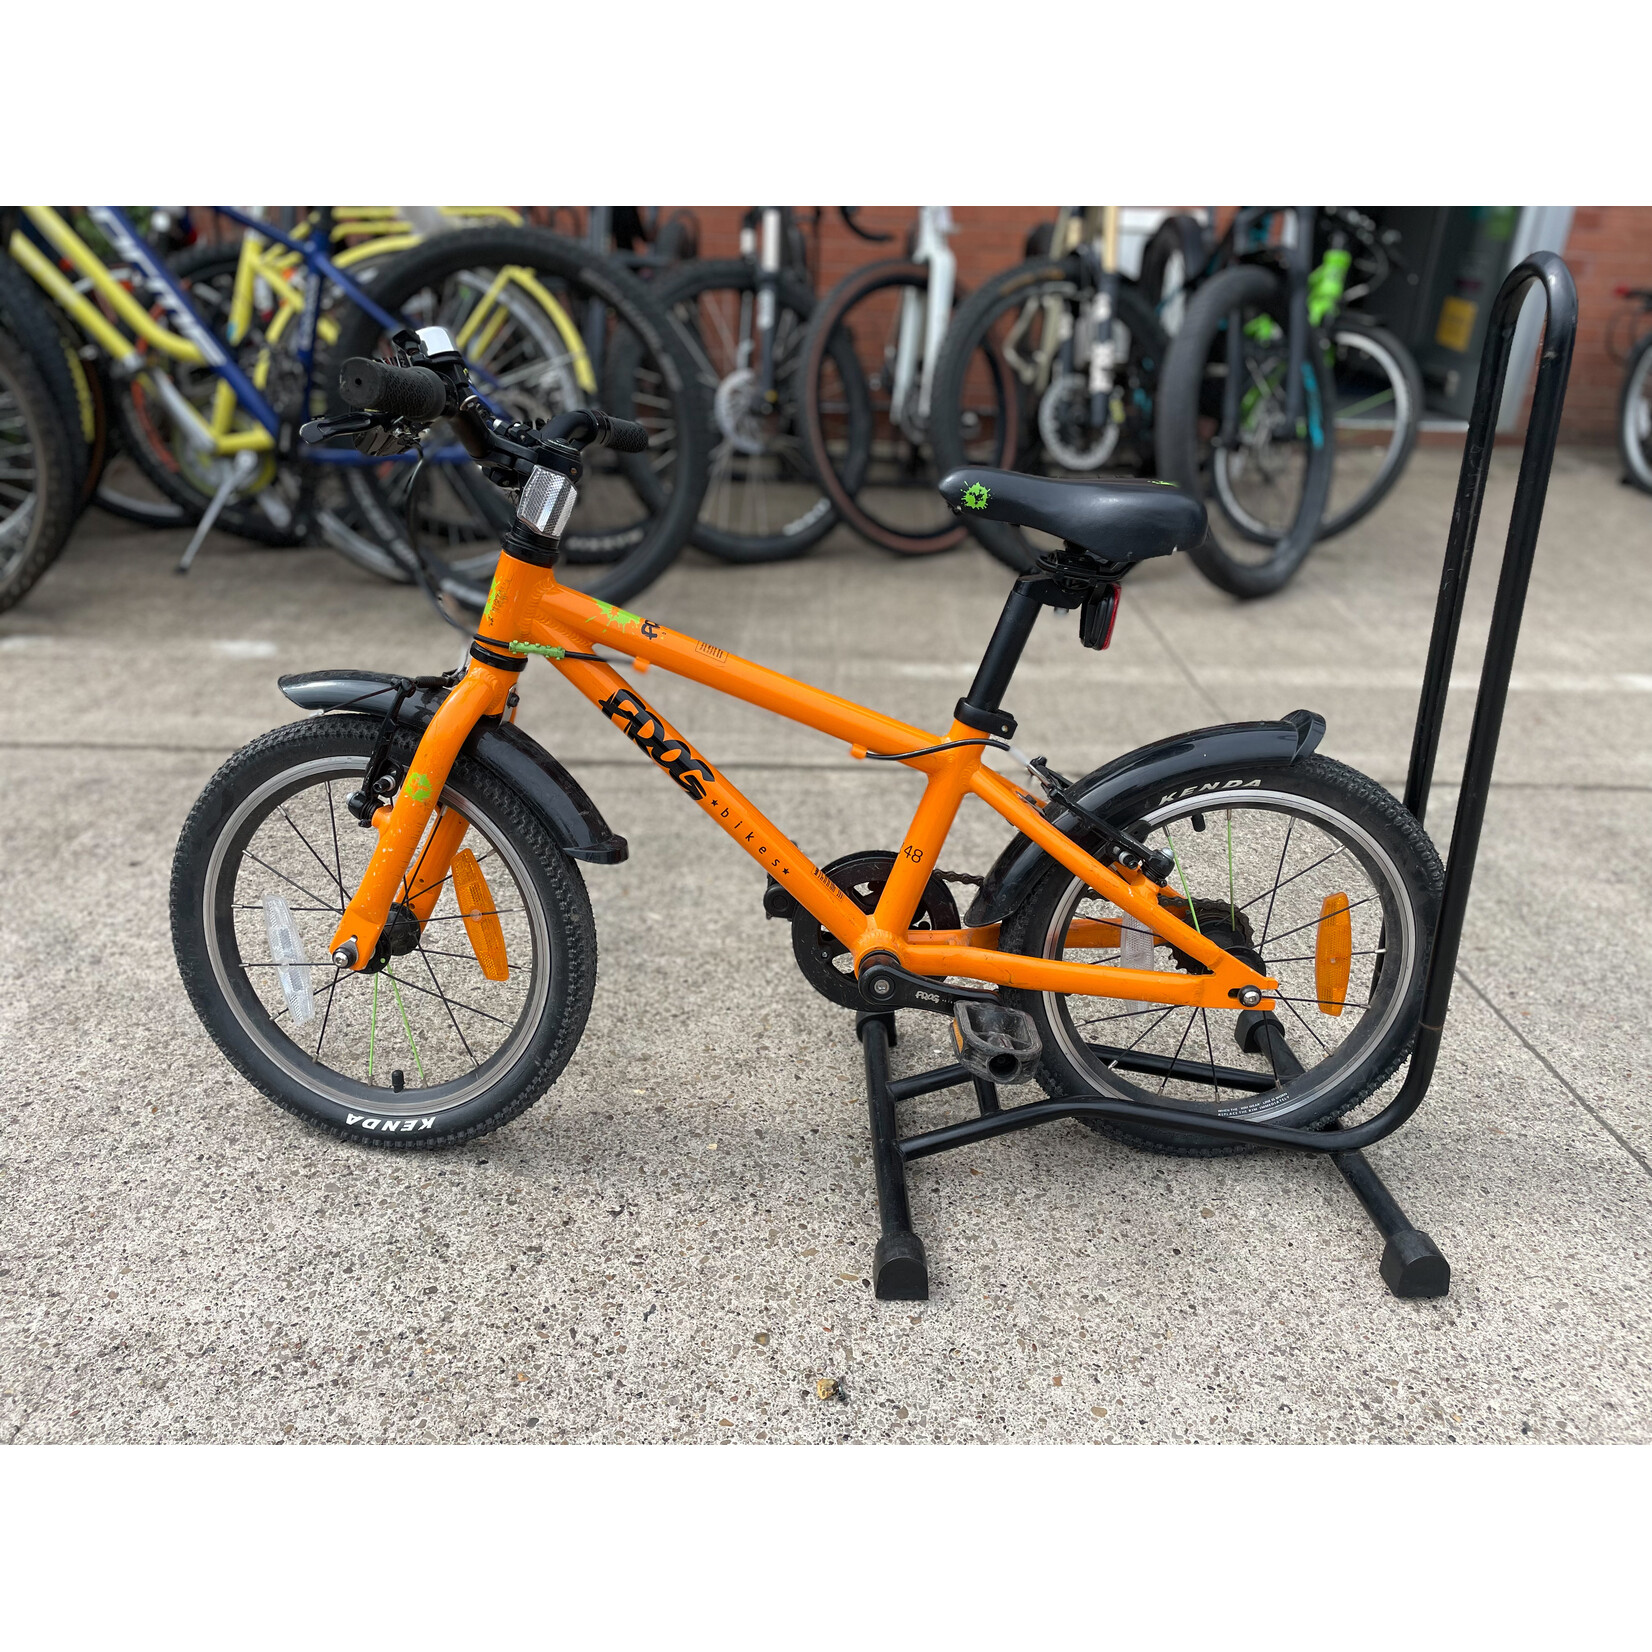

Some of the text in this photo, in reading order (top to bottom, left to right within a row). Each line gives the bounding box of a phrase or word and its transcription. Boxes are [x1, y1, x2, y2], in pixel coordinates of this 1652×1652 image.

[598, 689, 781, 867] FROG bikes
[1158, 779, 1262, 806] KENDA
[904, 845, 923, 863] 48
[915, 990, 940, 1004] FROG
[345, 1113, 437, 1132] KENDA
